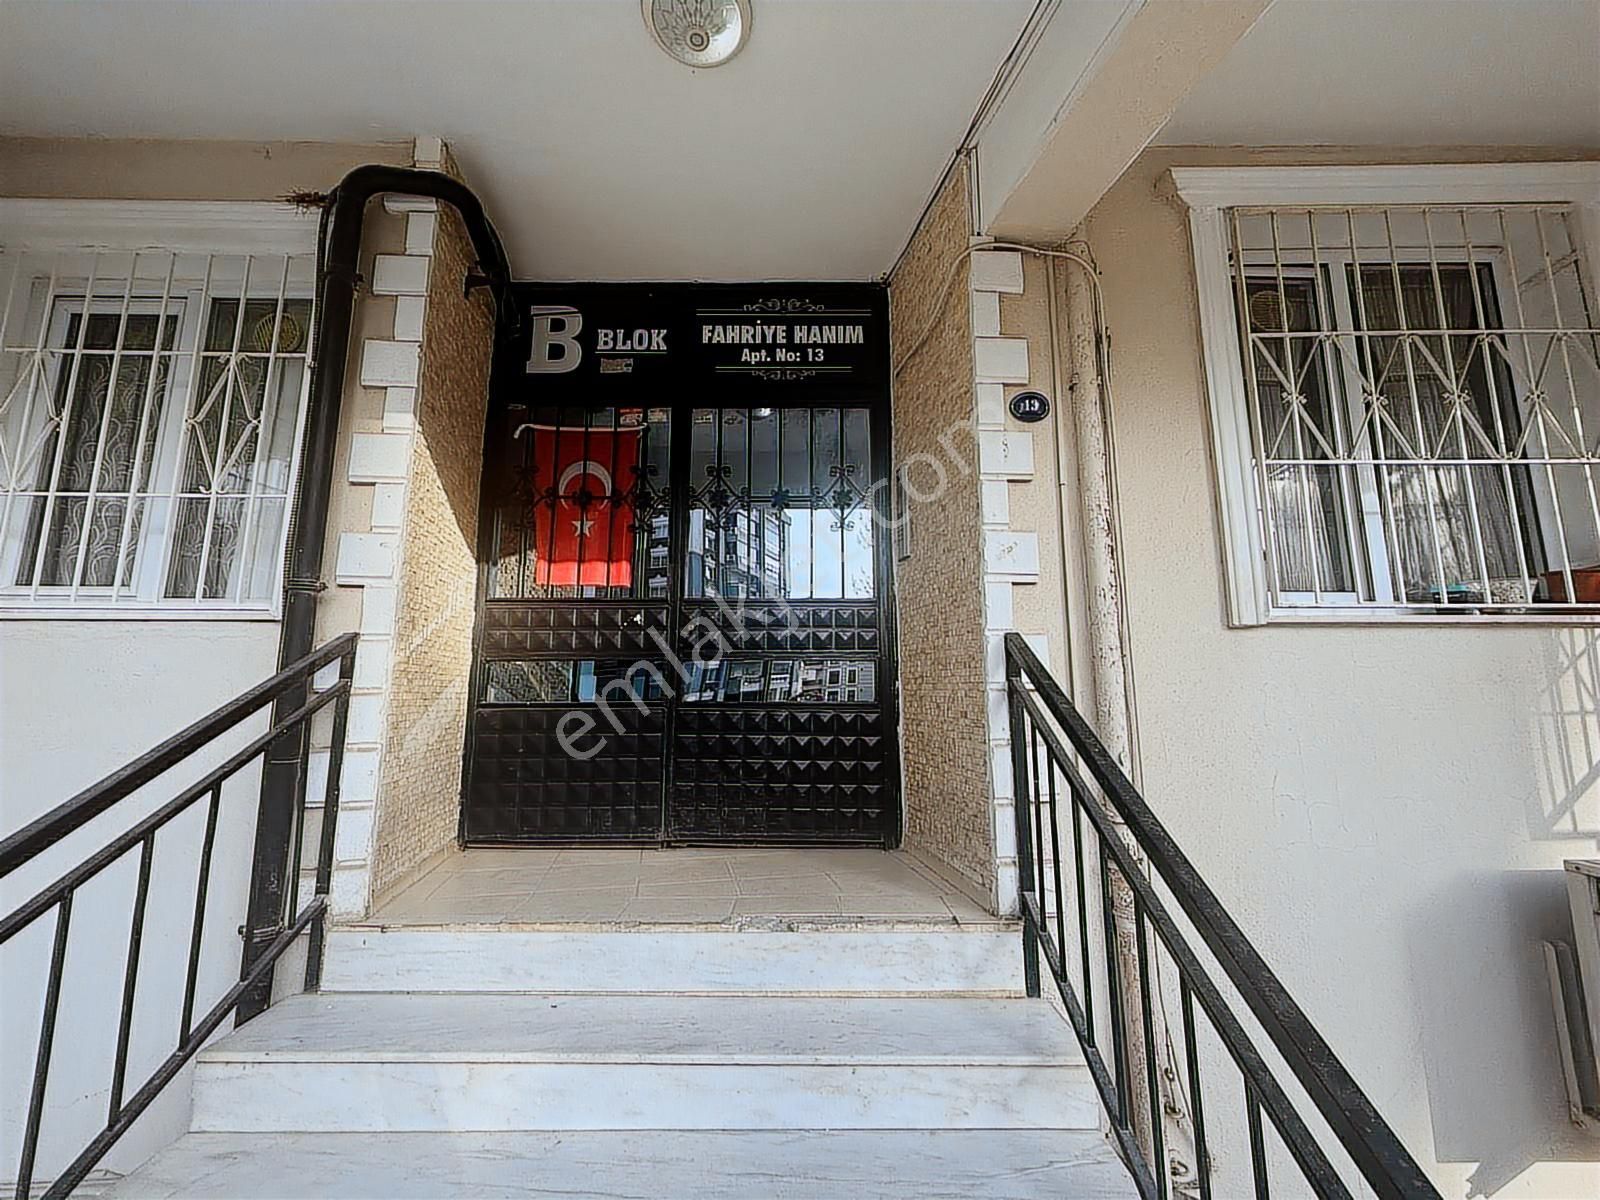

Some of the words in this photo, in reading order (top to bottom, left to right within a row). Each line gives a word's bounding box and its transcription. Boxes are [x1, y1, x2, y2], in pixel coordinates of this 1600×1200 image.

[526, 305, 583, 373] B
[597, 329, 668, 350] BLOK
[702, 319, 787, 344] FAHRİYE
[794, 325, 864, 344] HANIM
[741, 348, 771, 365] Apt.
[776, 348, 801, 362] No:
[807, 348, 825, 362] 13
